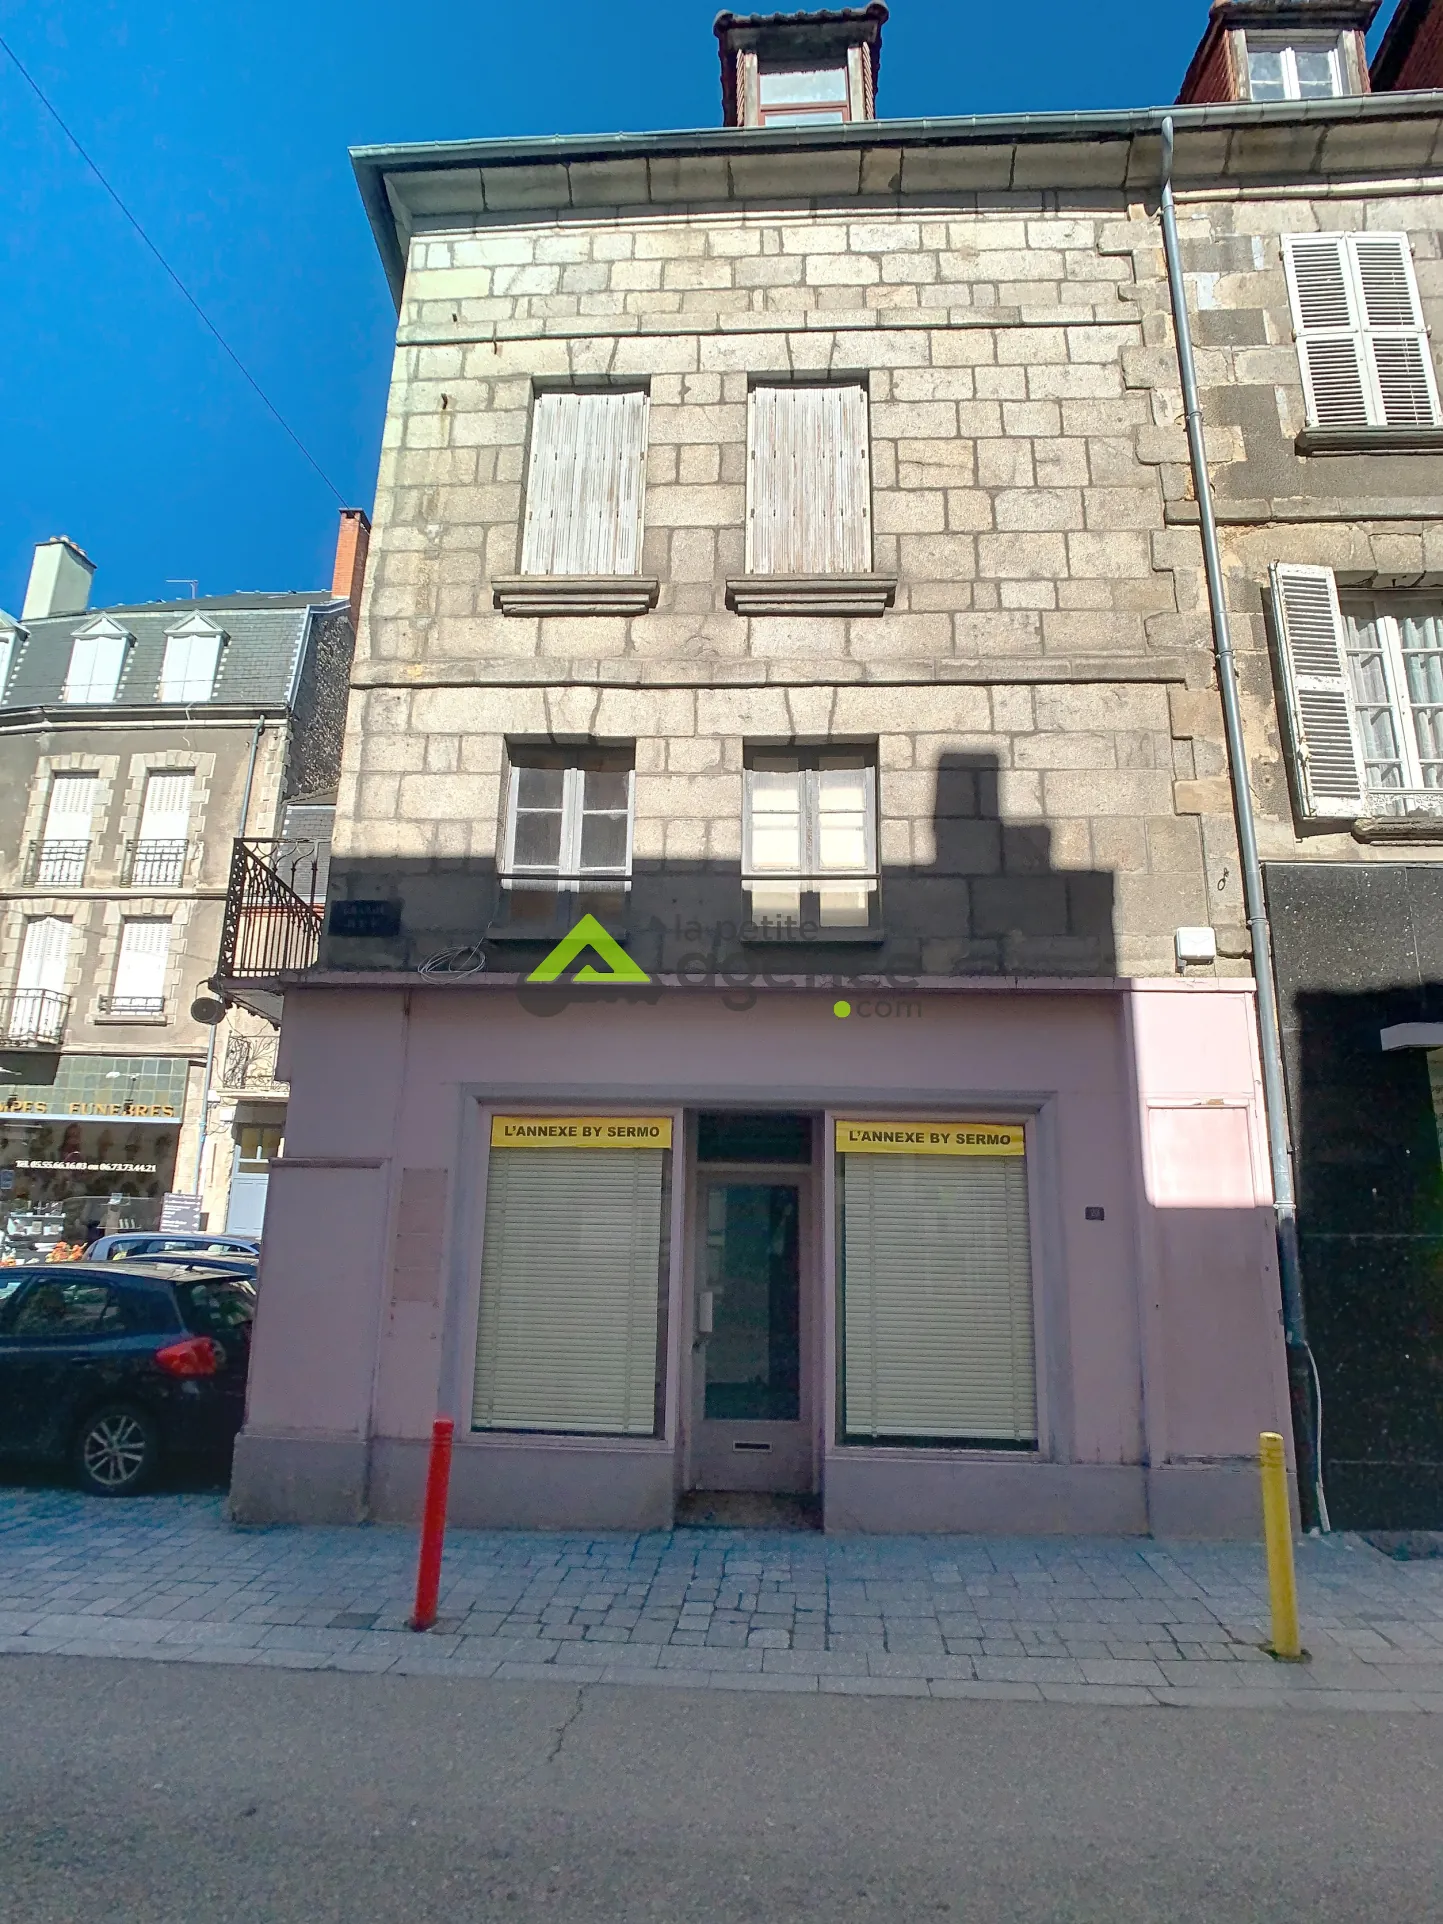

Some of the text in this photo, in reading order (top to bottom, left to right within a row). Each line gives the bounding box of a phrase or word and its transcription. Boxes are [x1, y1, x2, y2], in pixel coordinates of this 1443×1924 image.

[504, 1125, 660, 1138] L'ANNEXE BY SERMO
[849, 1130, 1011, 1145] L'ANNEXE BY SERMO
